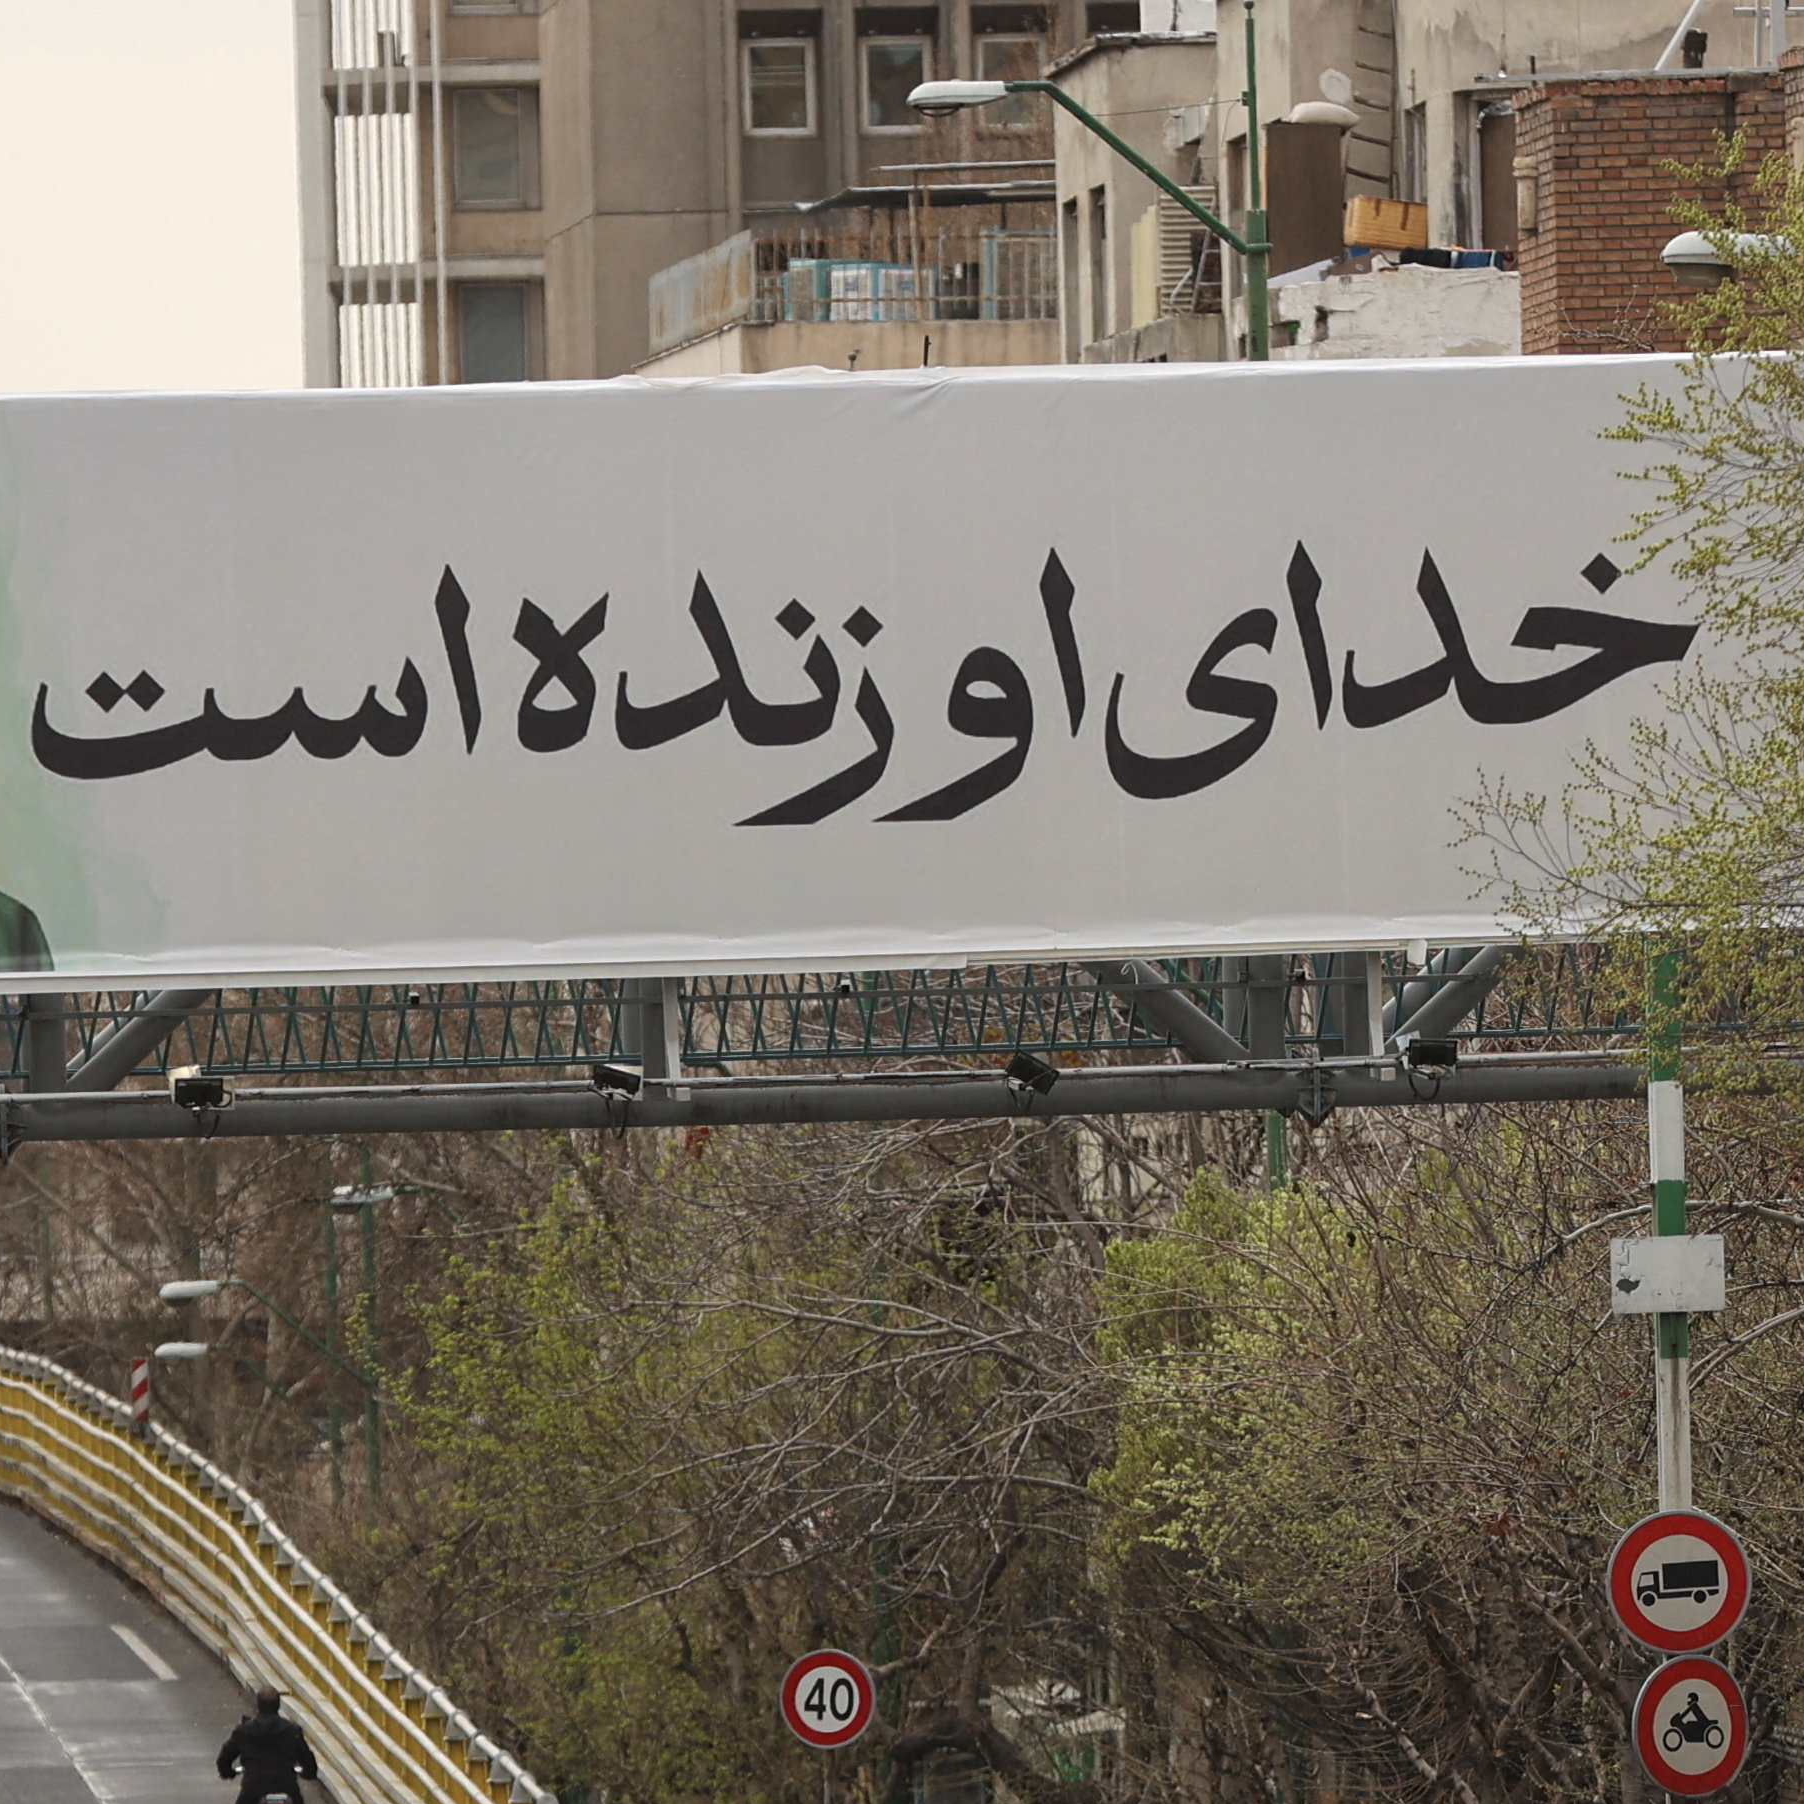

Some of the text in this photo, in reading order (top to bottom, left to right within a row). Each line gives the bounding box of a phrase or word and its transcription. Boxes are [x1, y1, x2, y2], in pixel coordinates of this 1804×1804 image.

[32, 541, 1700, 826] خدای او زنده است
[804, 1678, 854, 1721] 40
